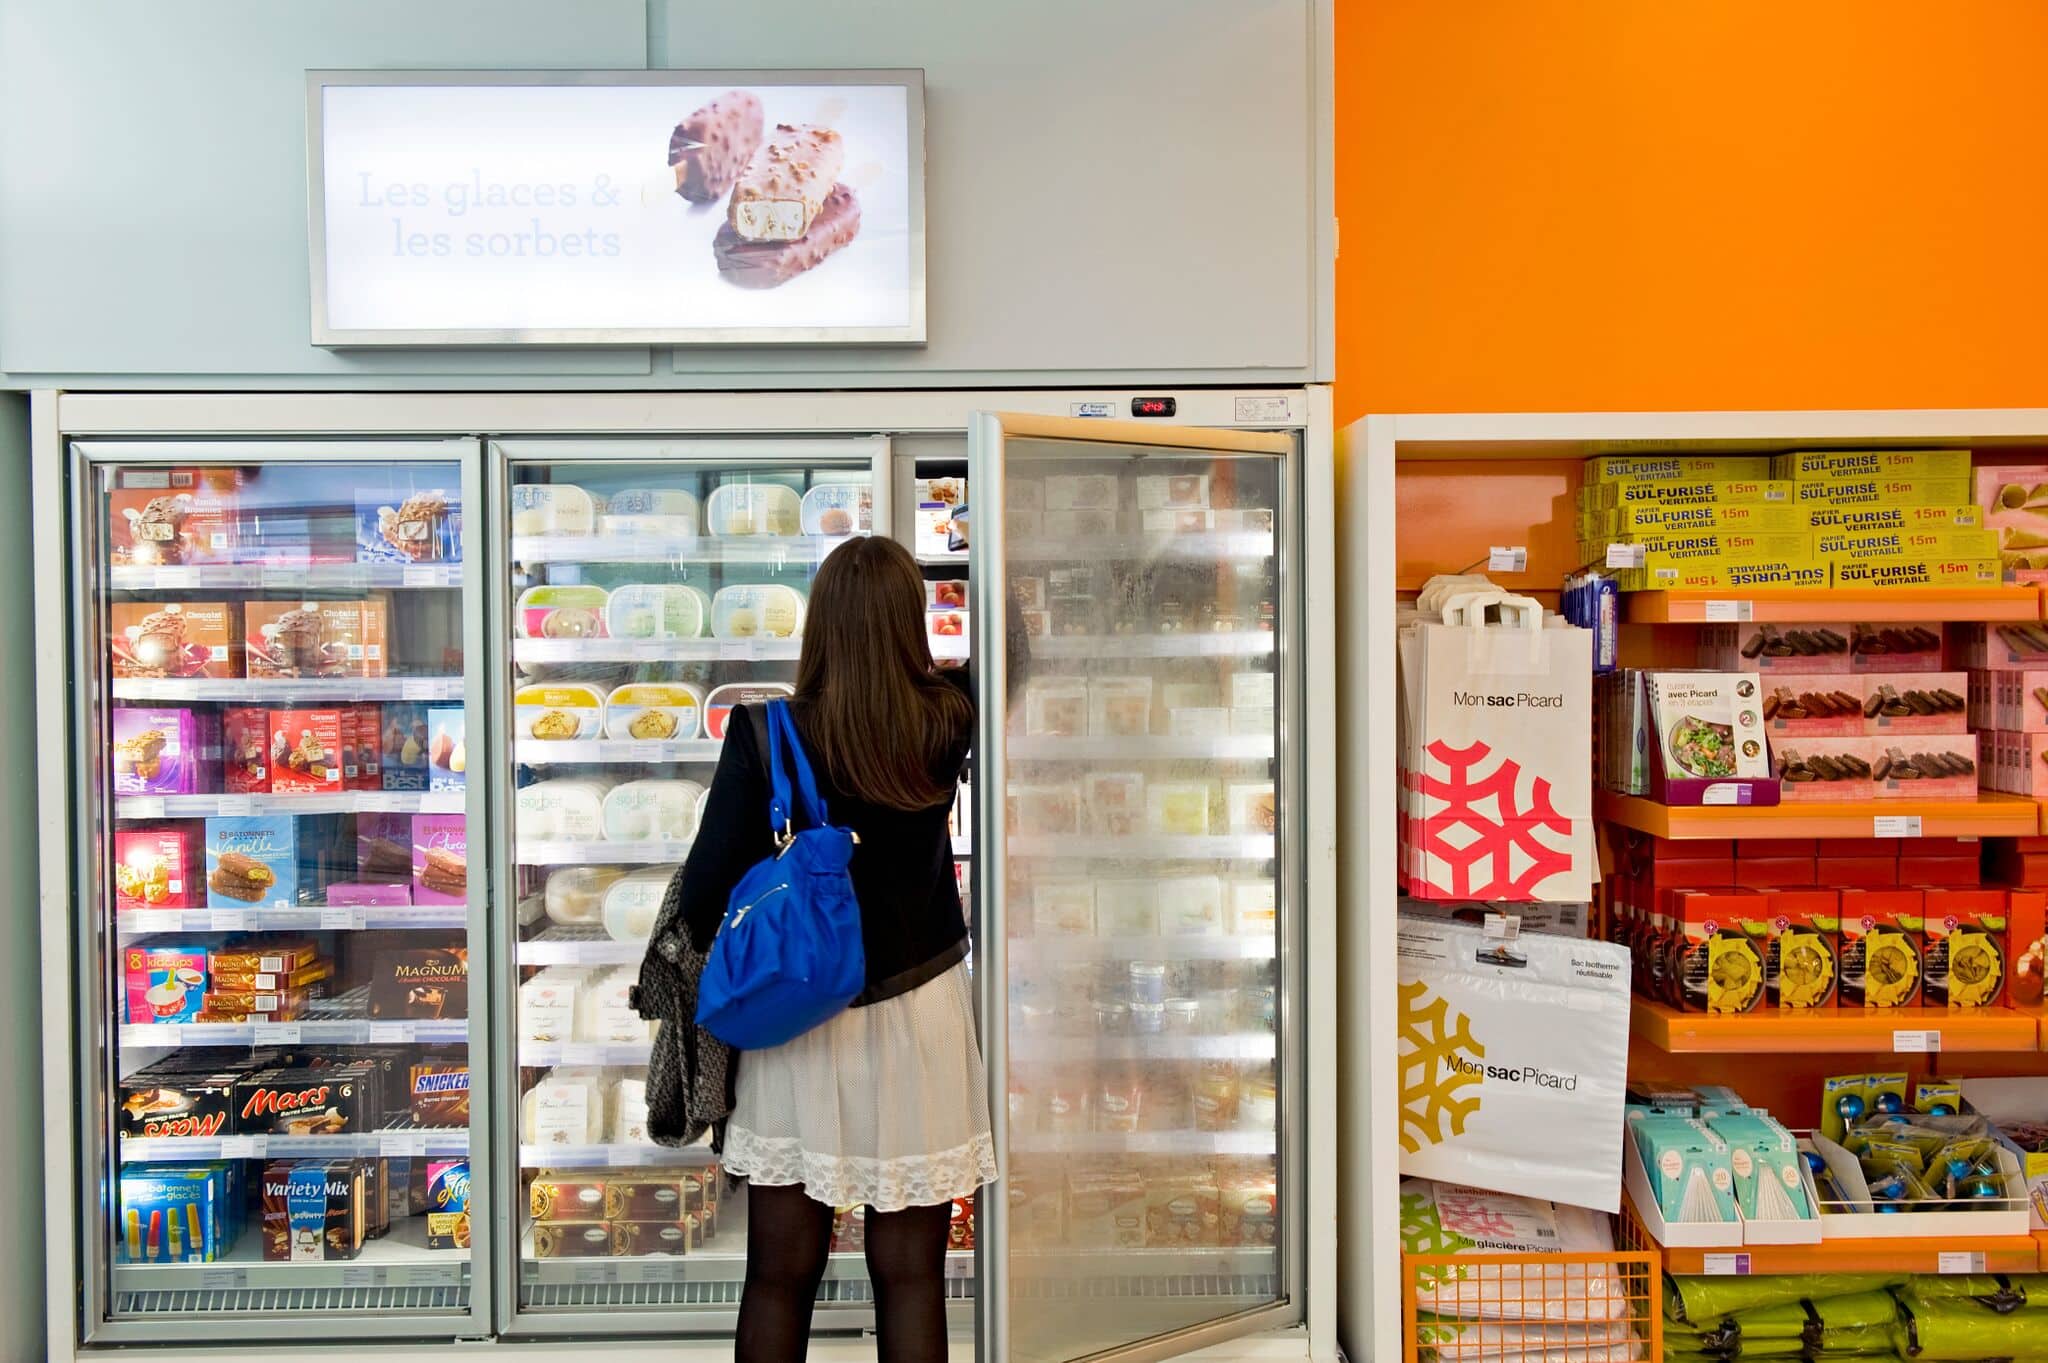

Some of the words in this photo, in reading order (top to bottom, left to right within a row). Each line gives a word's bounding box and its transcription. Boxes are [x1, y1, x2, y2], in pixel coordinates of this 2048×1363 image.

[358, 172, 434, 208] Les
[445, 168, 579, 216] glaces
[590, 173, 620, 208] &
[392, 218, 455, 258] les
[465, 218, 621, 258] sorbets
[1606, 459, 1681, 477] SULFURISÉ
[1687, 461, 1715, 471] 15m
[1801, 454, 1878, 472] SULFURISÉ
[1886, 455, 1914, 465] 15m
[1830, 466, 1881, 477] VERITABLE
[1634, 471, 1683, 481] VERITABLE
[1625, 484, 1715, 501] SULFURISÉ
[1726, 483, 1758, 494] 15m
[1800, 481, 1877, 500] SULFURISÉ
[1884, 482, 1912, 493] 15m
[1829, 493, 1879, 505] VERITABLE
[1659, 495, 1718, 506] VERITABLE
[1635, 506, 1713, 525] SULFURISÉ
[1721, 508, 1749, 519] 15m
[1810, 508, 1902, 526] SULFURISÉ
[1913, 508, 1946, 519] 15m
[1664, 519, 1717, 531] VERITABLE
[1845, 520, 1905, 532] VERITABLE
[1726, 537, 1754, 548] 15m
[1819, 534, 1900, 553] SULFURISÉ
[1908, 535, 1937, 546] 15m
[1669, 548, 1721, 560] VERITABLE
[1850, 546, 1903, 559] VERITABLE
[1840, 562, 1927, 581] SULFURISÉ
[1938, 563, 1969, 574] 15m
[1684, 576, 1718, 586] 15m
[1873, 575, 1931, 586] VERITABLE
[1453, 691, 1485, 707] Mon
[1487, 694, 1515, 707] sac
[1517, 693, 1563, 708] Picard
[1668, 690, 1688, 698] avec
[1690, 689, 1718, 698] Picard
[130, 953, 142, 970] 8
[395, 964, 466, 977] MAGNUM
[1446, 1055, 1484, 1076] Mon
[1486, 1063, 1520, 1082] sac
[1522, 1066, 1577, 1091] Picard
[241, 1086, 330, 1119] Mars
[342, 1086, 352, 1097] 6
[266, 1181, 320, 1198] Variety
[323, 1181, 349, 1196] Mix
[1477, 1240, 1526, 1252] glacière
